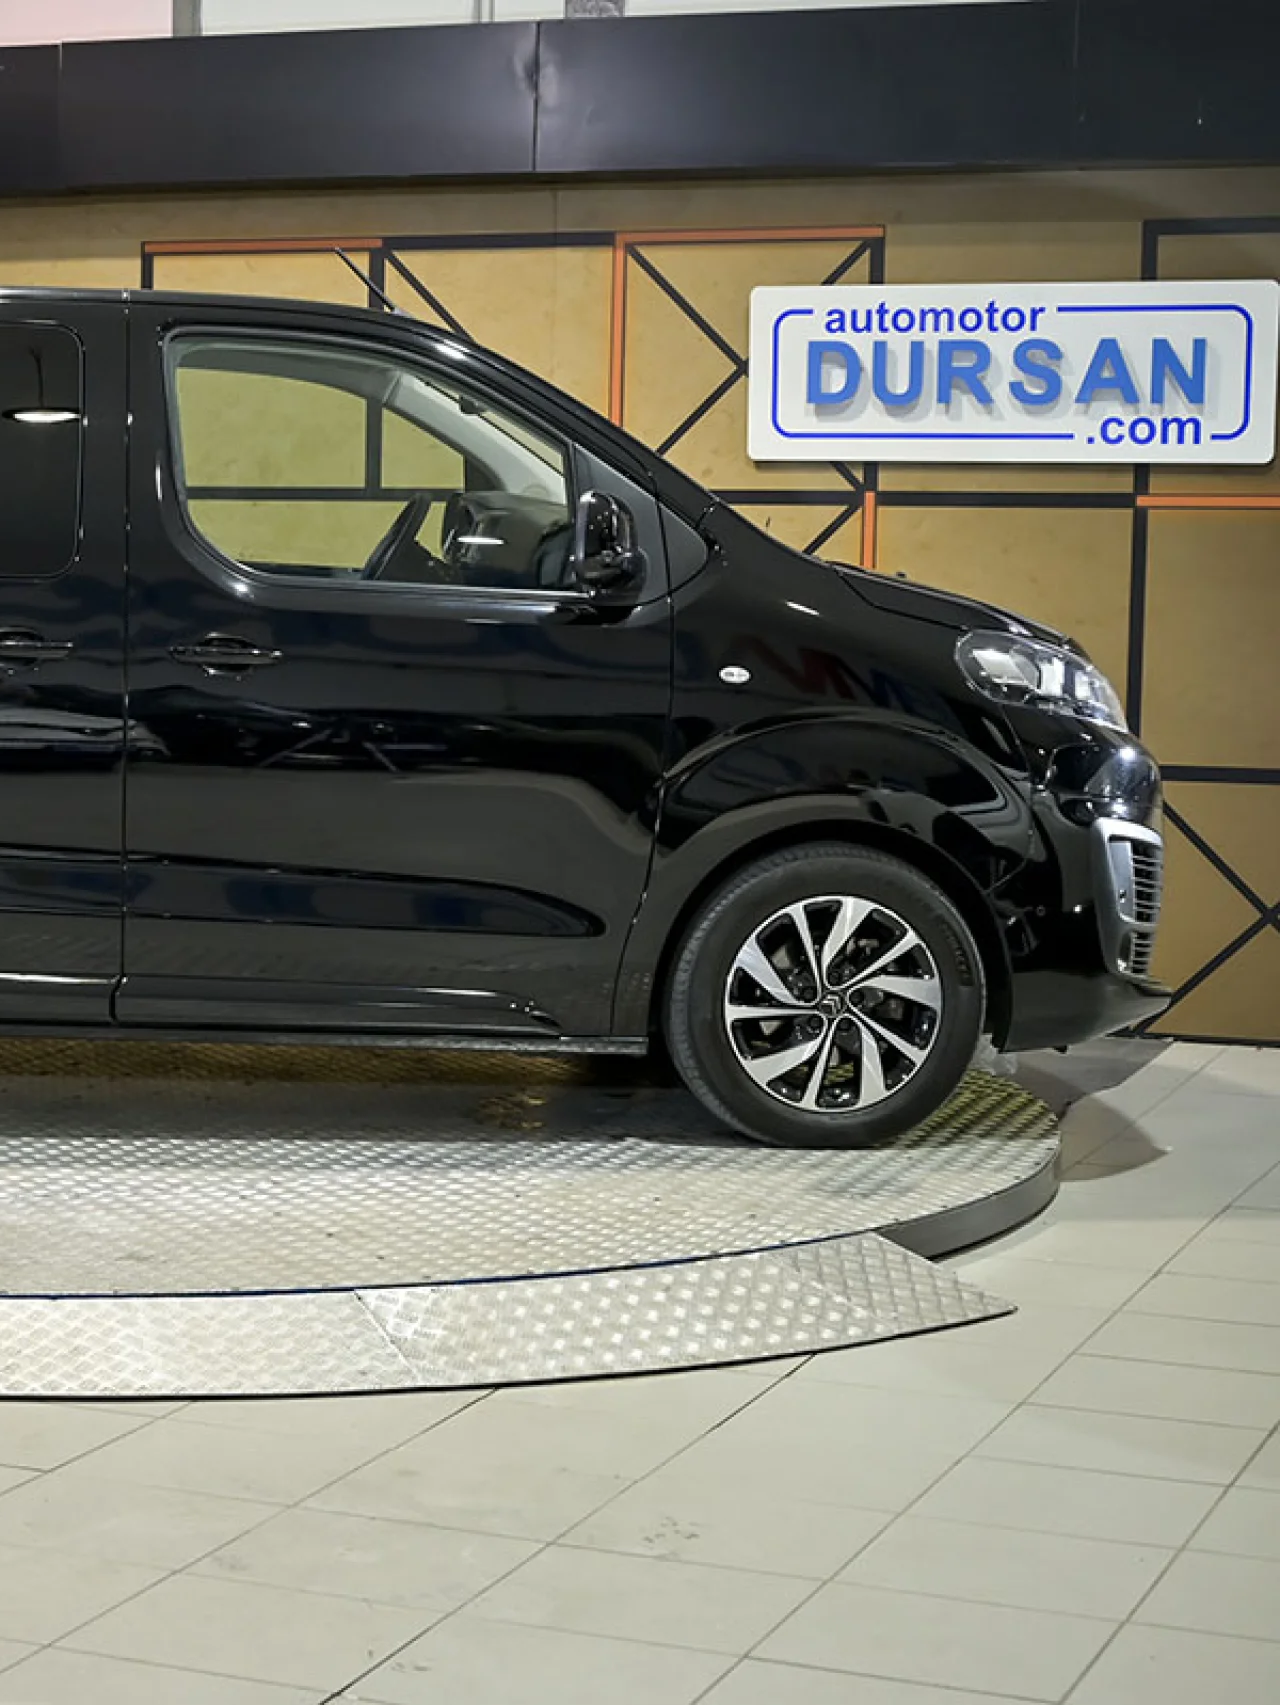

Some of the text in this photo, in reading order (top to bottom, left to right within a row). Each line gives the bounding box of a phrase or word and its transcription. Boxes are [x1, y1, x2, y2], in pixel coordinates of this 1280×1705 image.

[825, 302, 1044, 333] automotor
[807, 338, 1206, 405] DURSAN
[1087, 416, 1201, 445] .com
